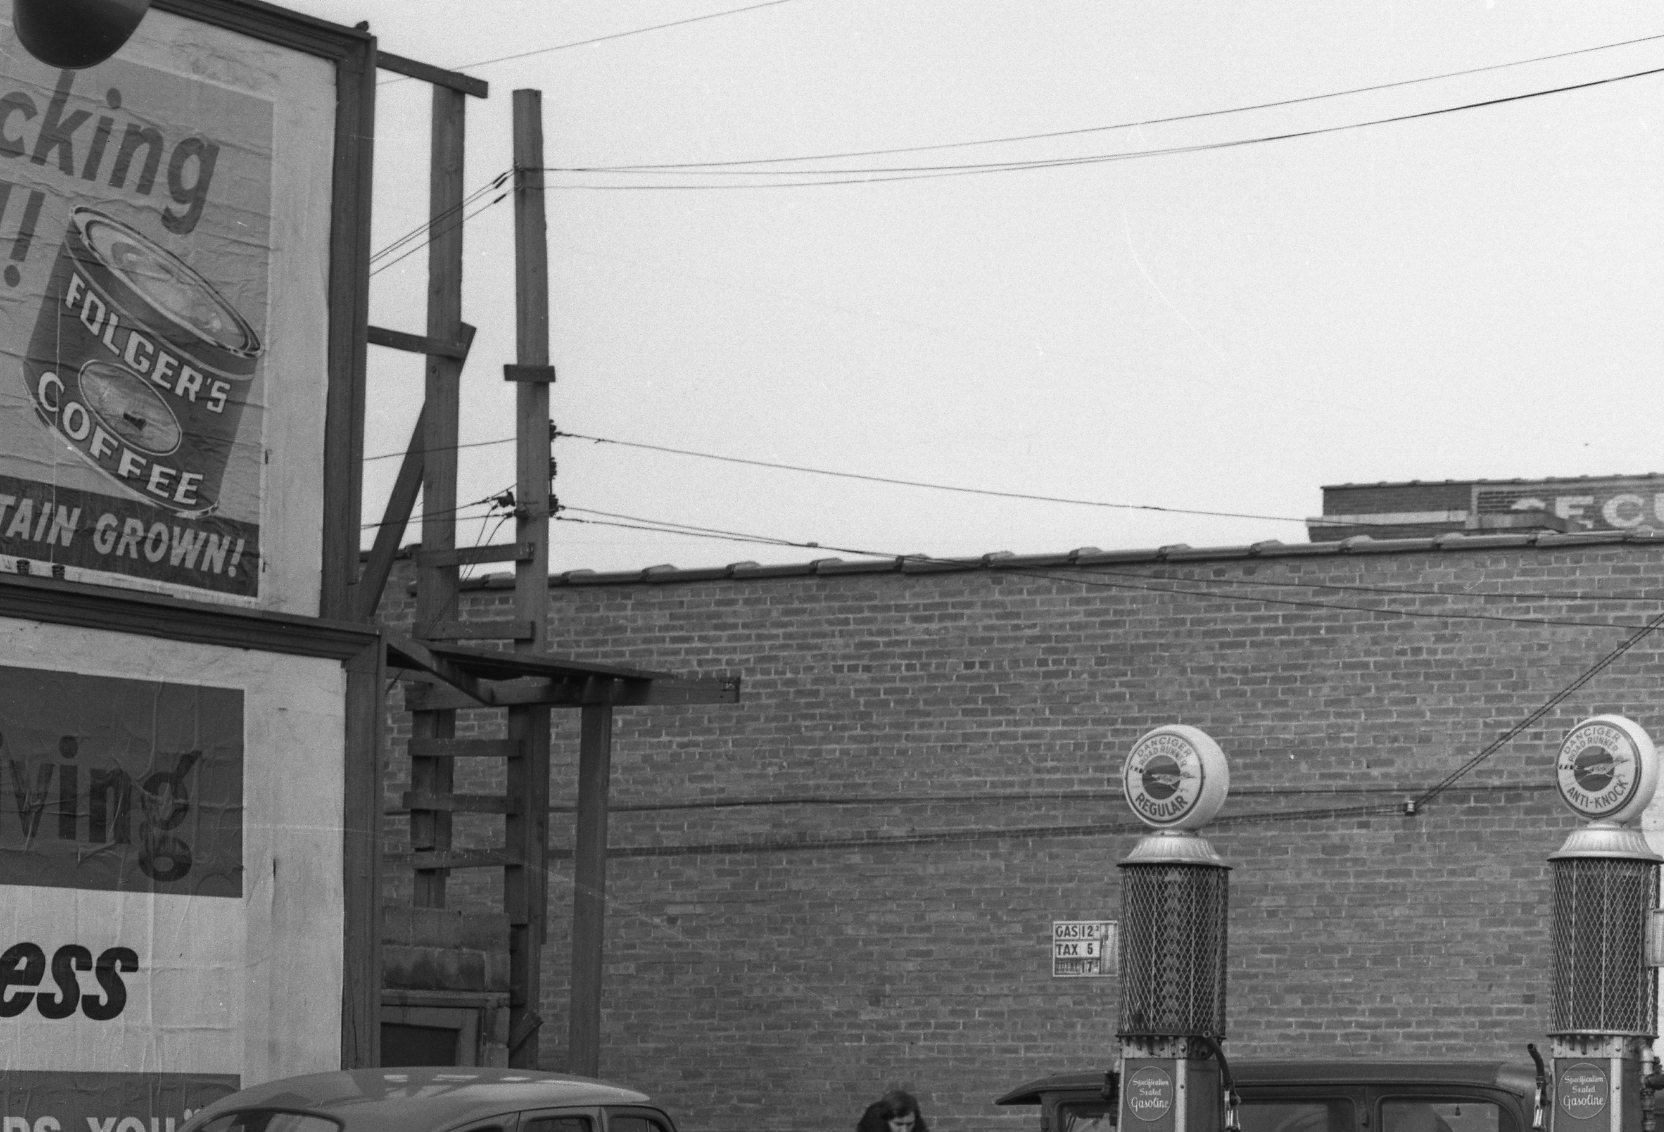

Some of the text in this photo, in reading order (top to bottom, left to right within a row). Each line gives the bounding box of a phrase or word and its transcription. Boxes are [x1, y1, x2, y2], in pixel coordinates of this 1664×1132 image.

[65, 271, 231, 413] FOLGER'S
[38, 371, 204, 506] COFFEE
[93, 512, 246, 578] GROWN!
[1137, 736, 1192, 758] DANCIGER
[1563, 727, 1622, 755] DANCIGER
[1135, 792, 1188, 818] REGULAR
[1567, 778, 1629, 809] ANTI-KNOCK
[1055, 925, 1079, 938] GAS
[1055, 942, 1094, 956] TAX 5
[0, 941, 139, 1021] ess
[1131, 1096, 1169, 1112] Gasoline
[1563, 1094, 1604, 1111] Gasoline
